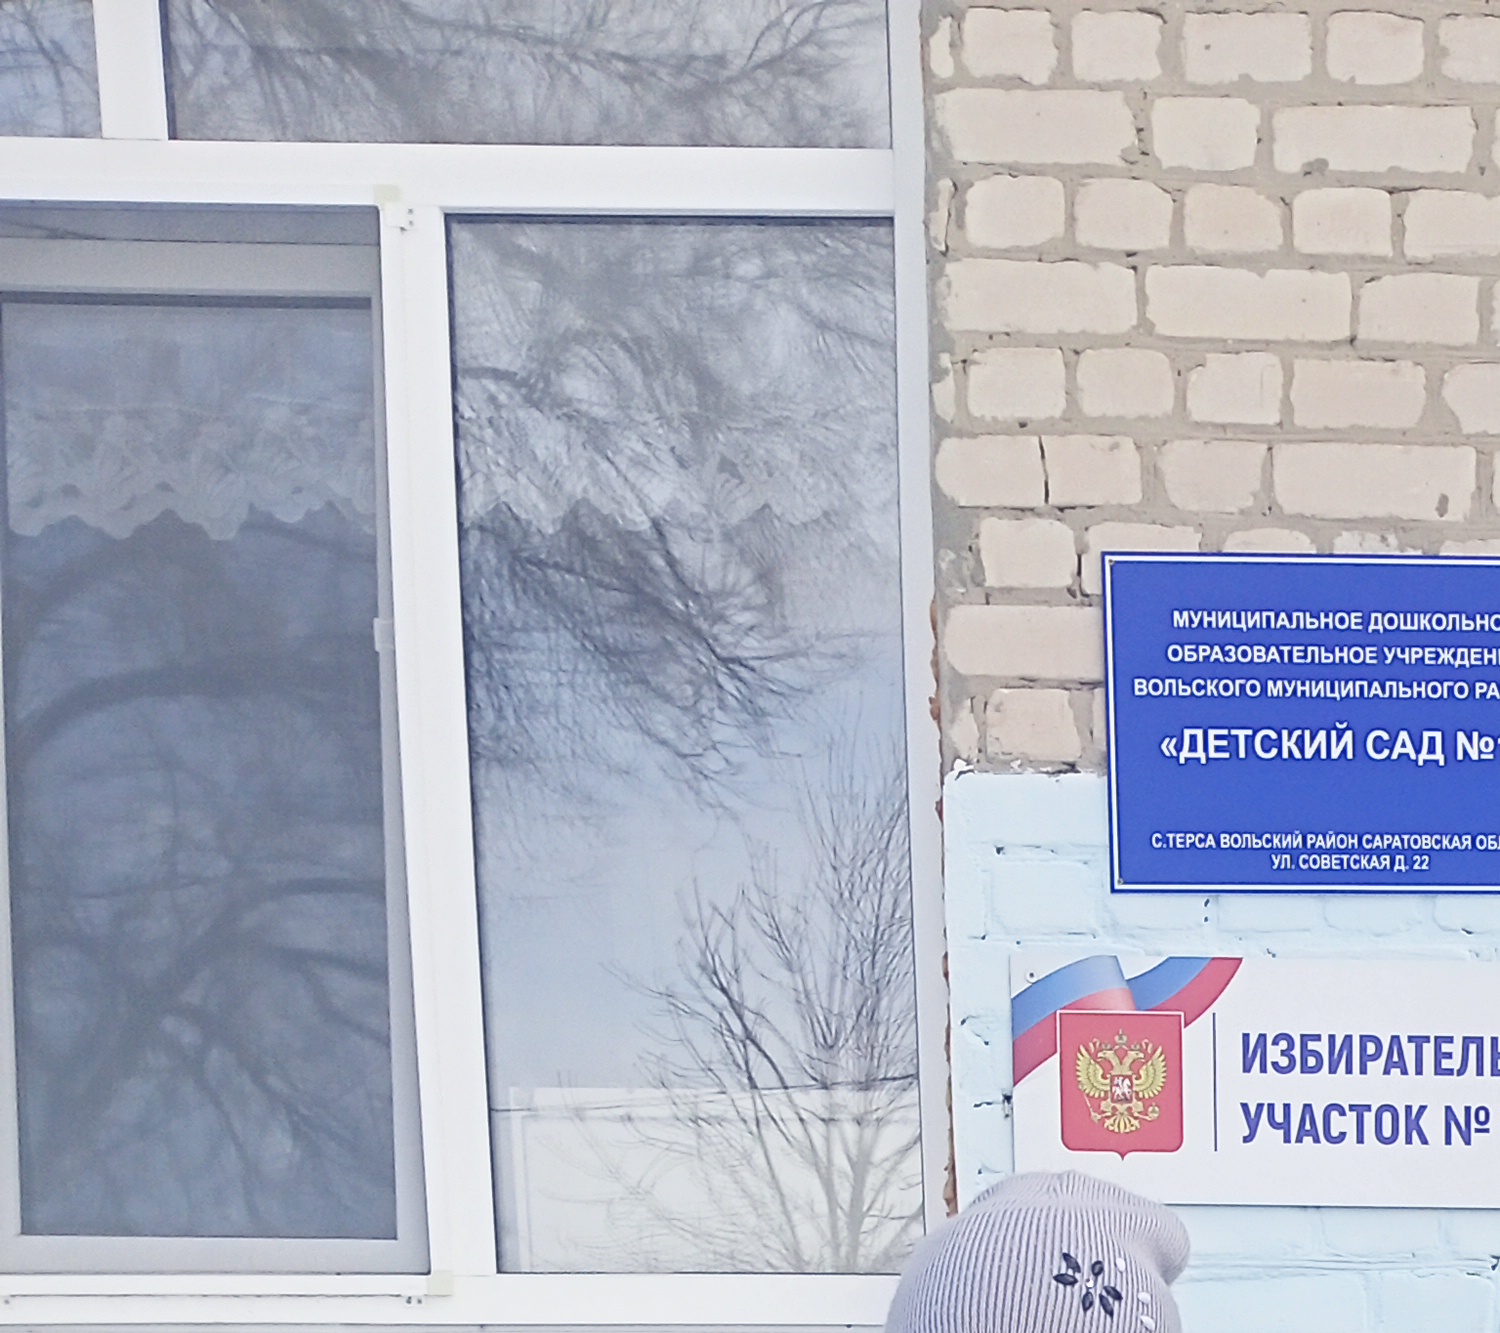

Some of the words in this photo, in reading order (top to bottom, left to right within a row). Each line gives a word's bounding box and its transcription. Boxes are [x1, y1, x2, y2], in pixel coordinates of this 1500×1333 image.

[1172, 610, 1363, 632] МУНИЦИПАЛЬНОЕ
[1166, 644, 1378, 665] ОБРАЗОВАТЕЛЬНОЕ
[1134, 678, 1261, 698] ВОЛЬСКОГО
[1266, 681, 1469, 701] МУНИЦИПАЛЬНОГО
[1159, 722, 1355, 764] «ДЕТСКИЙ
[1365, 730, 1445, 766] САД
[1151, 833, 1216, 850] С.ТЕРСА
[1220, 830, 1302, 850] ВОЛЬСКИЙ
[1306, 830, 1358, 851] РАЙОН
[1362, 835, 1472, 851] САРАТОВСКАЯ
[1271, 854, 1295, 870] УЛ.
[1299, 854, 1391, 870] СОВЕТСКАЯ
[1394, 855, 1410, 872] Д.
[1412, 855, 1430, 870] 22
[1240, 1101, 1430, 1147] УЧАСТОК
[1444, 1104, 1491, 1146] №
